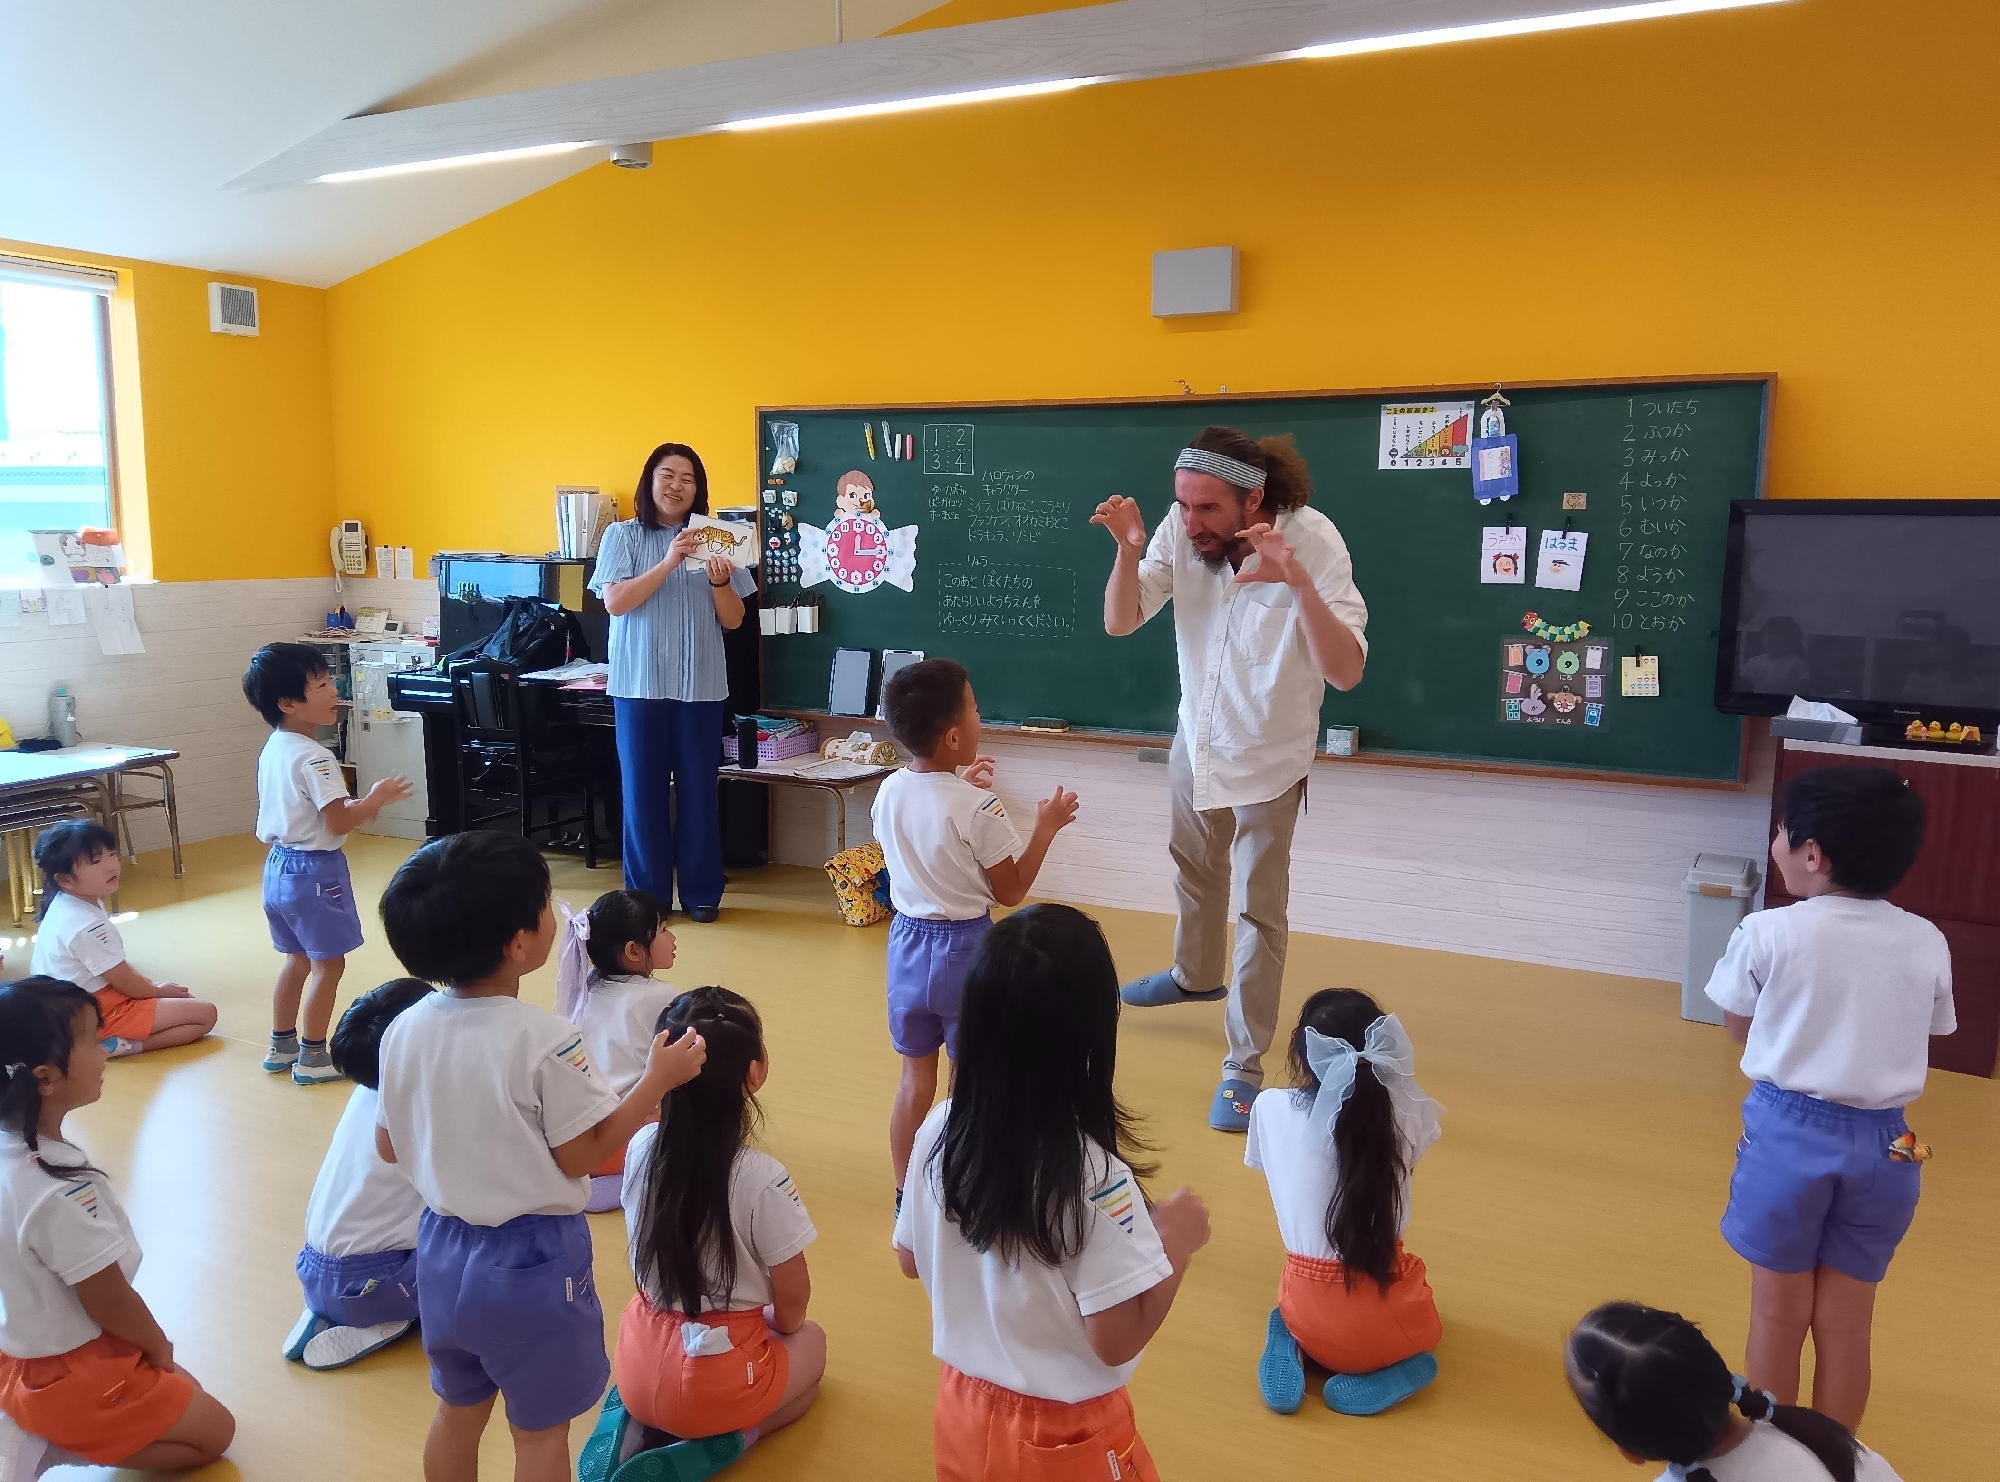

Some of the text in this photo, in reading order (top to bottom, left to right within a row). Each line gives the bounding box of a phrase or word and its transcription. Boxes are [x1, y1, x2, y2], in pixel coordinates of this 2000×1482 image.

[1628, 398, 1700, 418] 1 ついたち
[934, 428, 966, 446] 1 2
[1622, 422, 1692, 442] 2 ふつか
[932, 454, 966, 472] 3 4
[1623, 446, 1690, 467] 3 みっか
[981, 468, 1035, 482] ハロウィンの
[1618, 471, 1687, 490] 4 よっか
[982, 484, 1029, 496] キャラクター
[1621, 494, 1688, 514] 5 いつか
[1619, 518, 1687, 537] 6 むいか
[1488, 532, 1522, 548] うみか
[1545, 536, 1578, 552] はるま
[1619, 542, 1688, 560] 7 なのか
[944, 574, 978, 589] このあと
[1617, 565, 1685, 584] 8 ようか
[942, 594, 1041, 608] あたらしいようちえんを
[1614, 588, 1695, 608] 9 ここのか
[1613, 613, 1686, 632] 10 とおか
[1536, 658, 1544, 667] 9
[1564, 660, 1572, 668] 9
